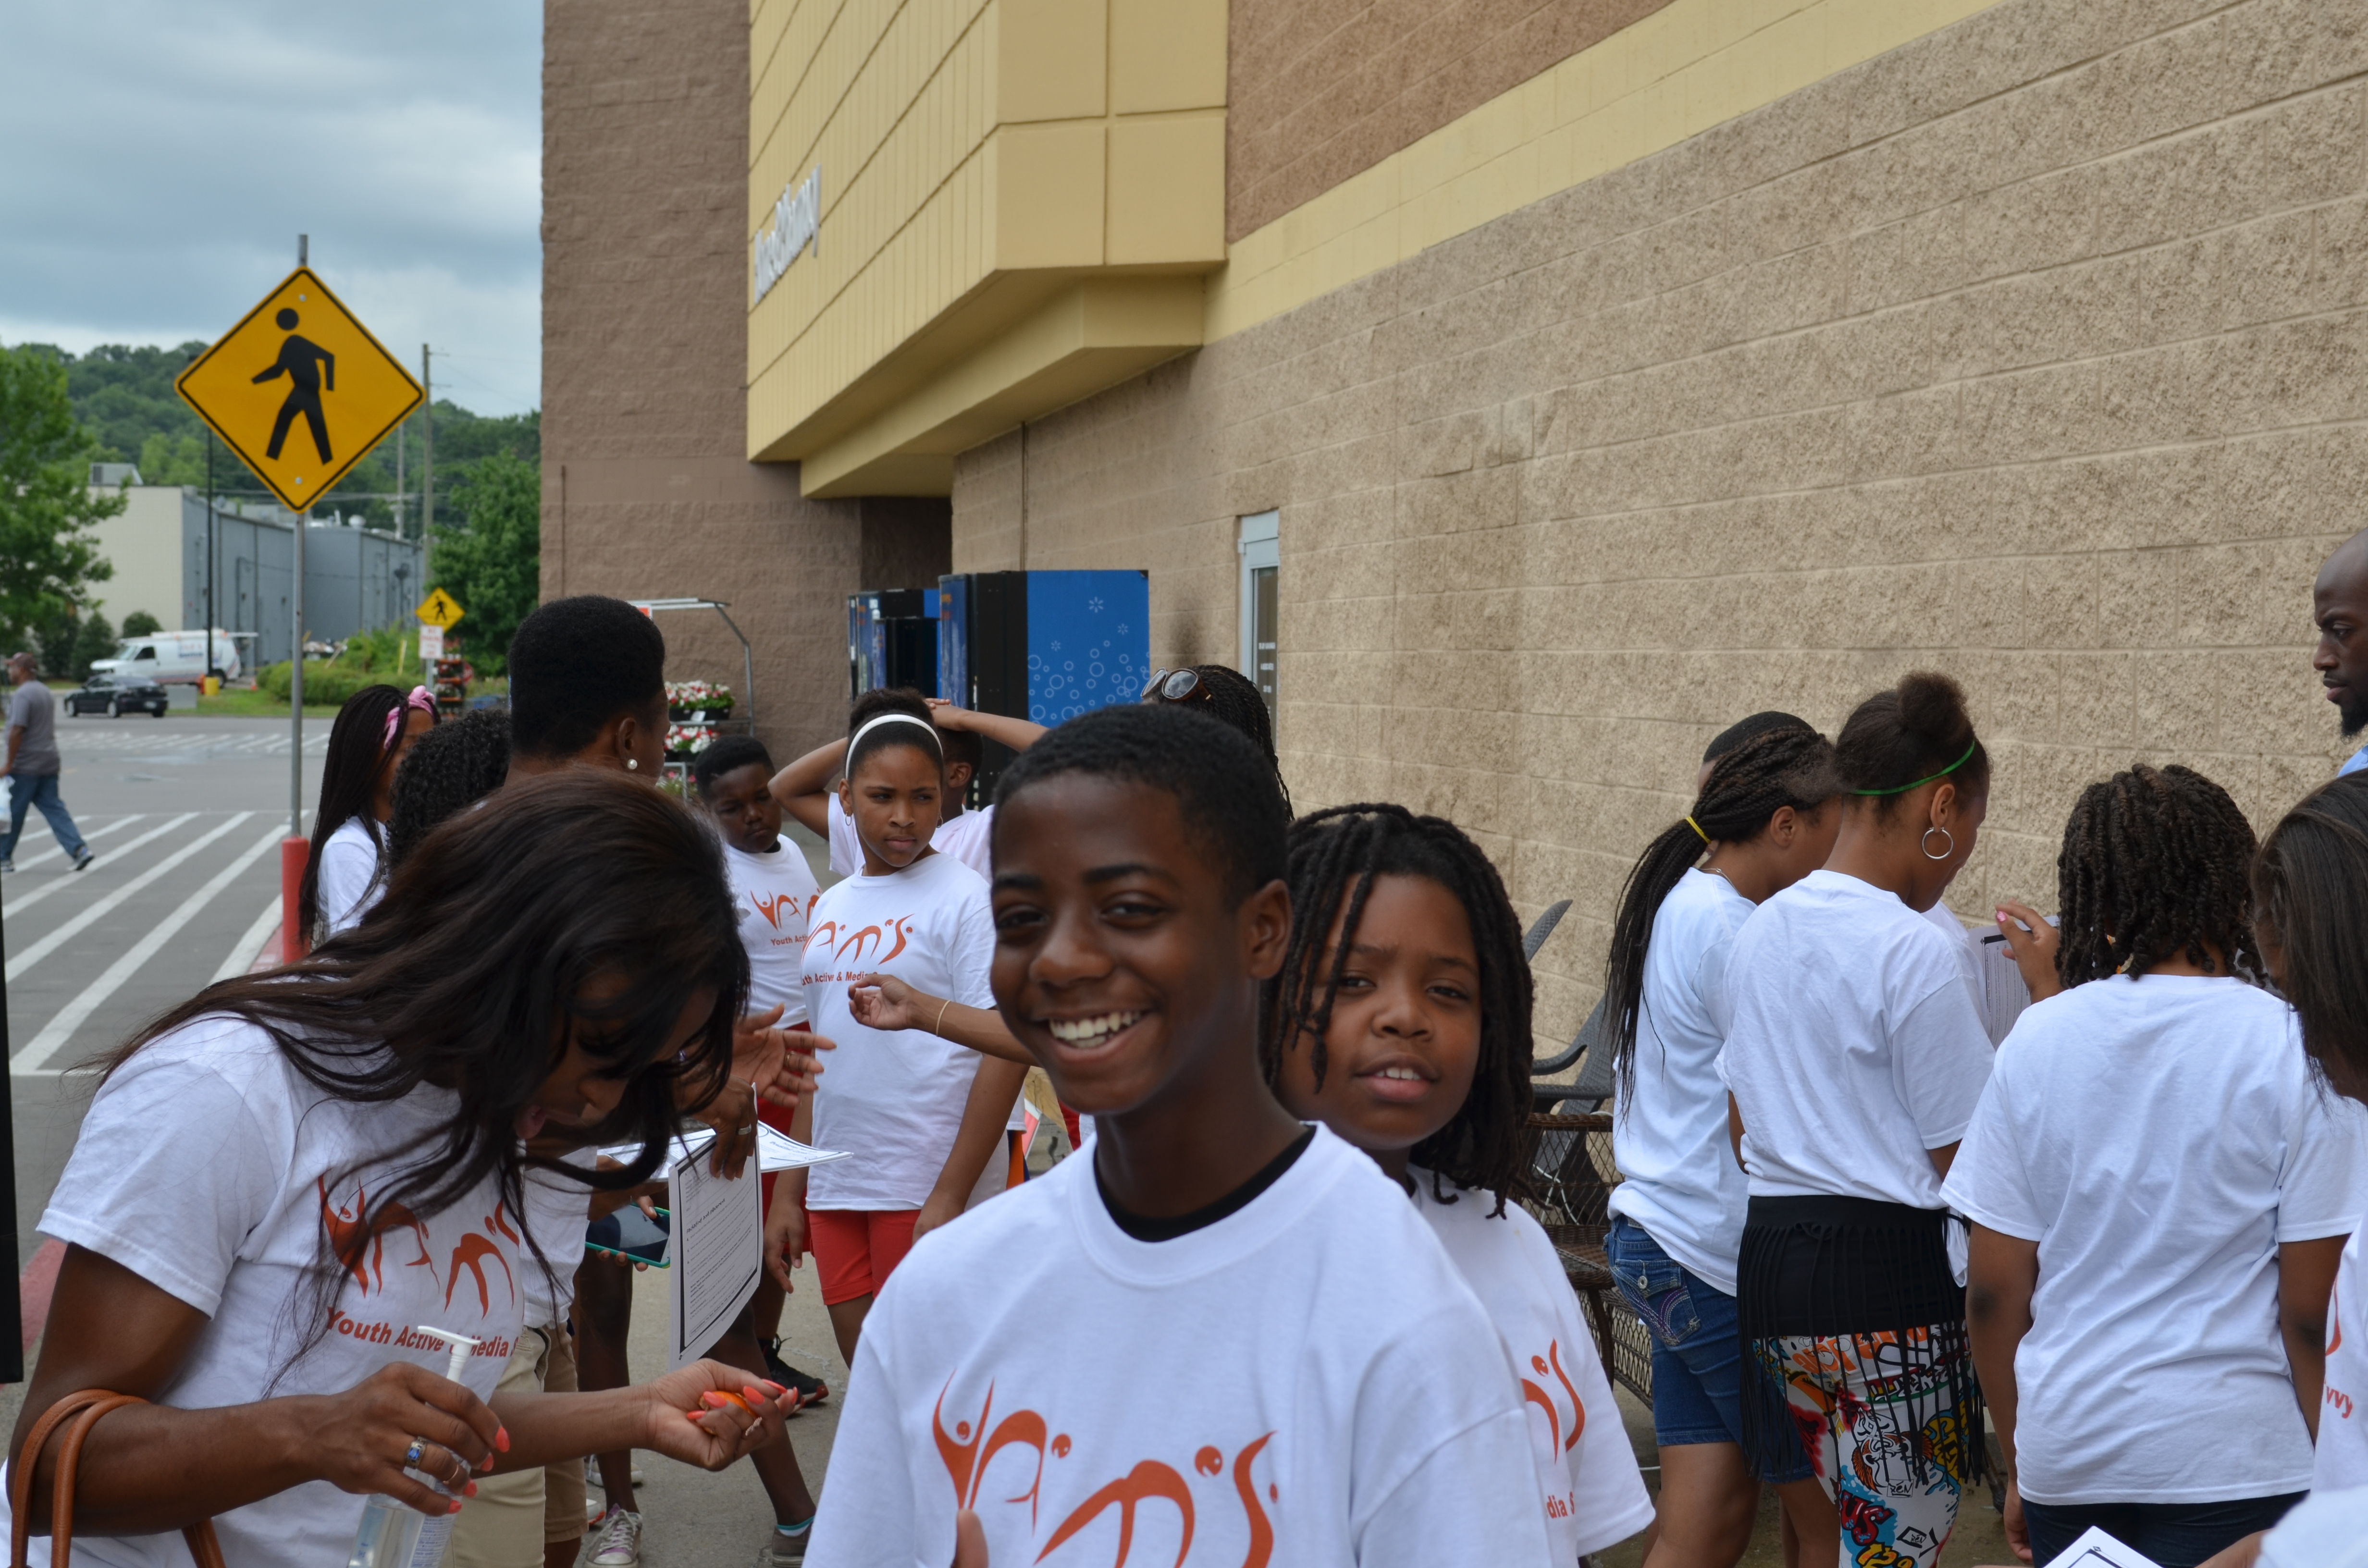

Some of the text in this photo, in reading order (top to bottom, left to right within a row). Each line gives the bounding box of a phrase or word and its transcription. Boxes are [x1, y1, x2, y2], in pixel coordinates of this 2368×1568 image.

[771, 936, 793, 945] Youth
[815, 972, 835, 983] Active
[837, 971, 842, 982] &
[327, 1307, 392, 1345] Youth
[394, 1325, 444, 1351] Active
